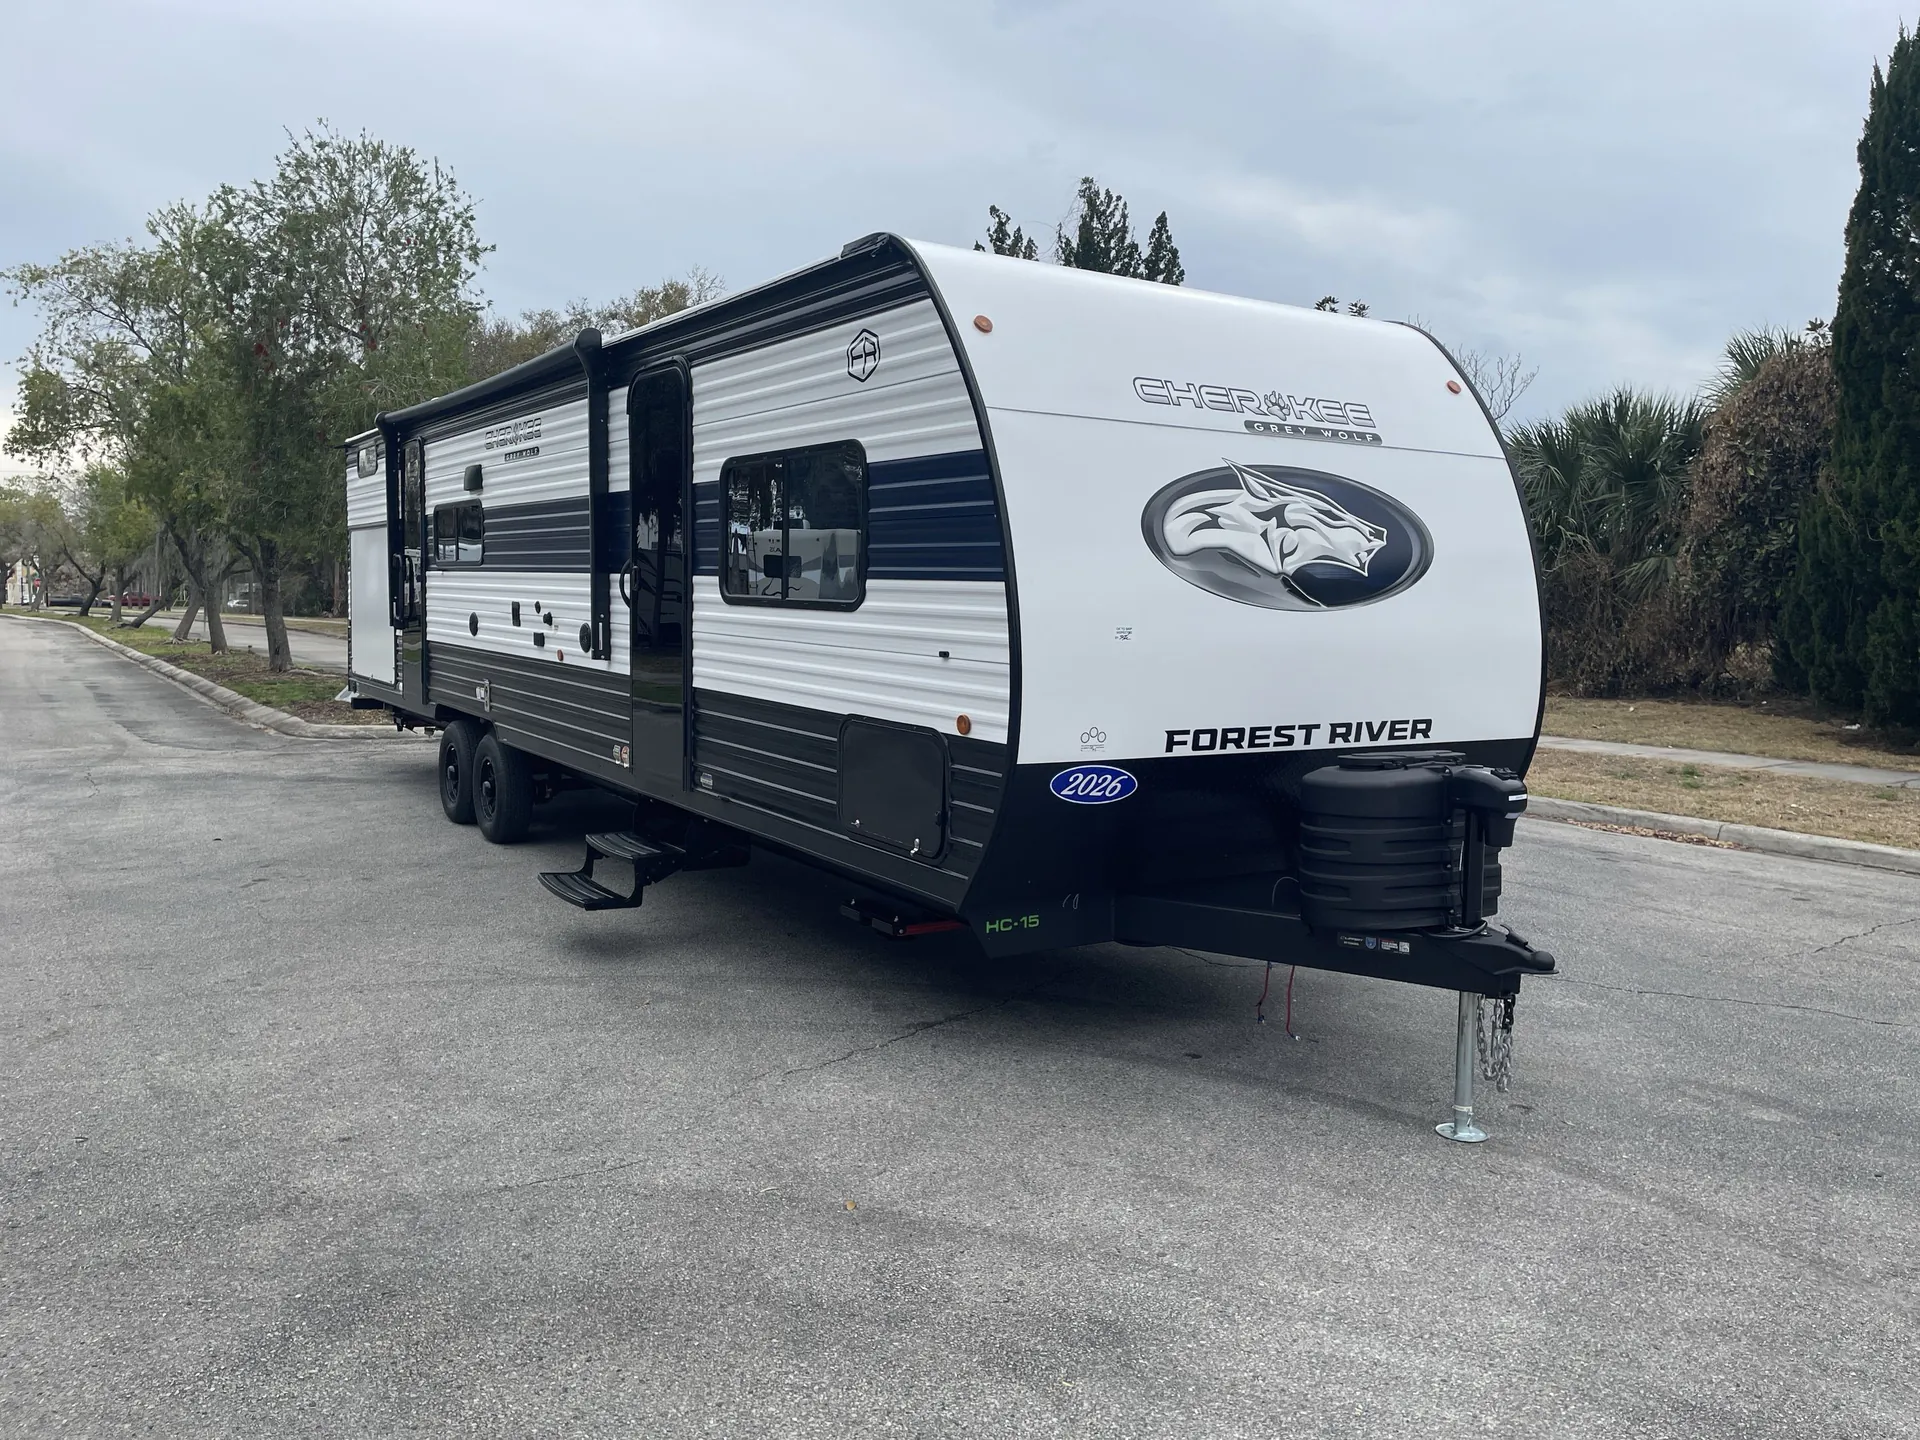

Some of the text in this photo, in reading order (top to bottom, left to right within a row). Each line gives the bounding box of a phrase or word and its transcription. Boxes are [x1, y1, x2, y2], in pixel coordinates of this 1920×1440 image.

[1253, 422, 1374, 442] GREY WOLF
[1164, 718, 1432, 753] FOREST RIVER
[1060, 773, 1129, 797] 2026
[986, 914, 1040, 934] HC-15
